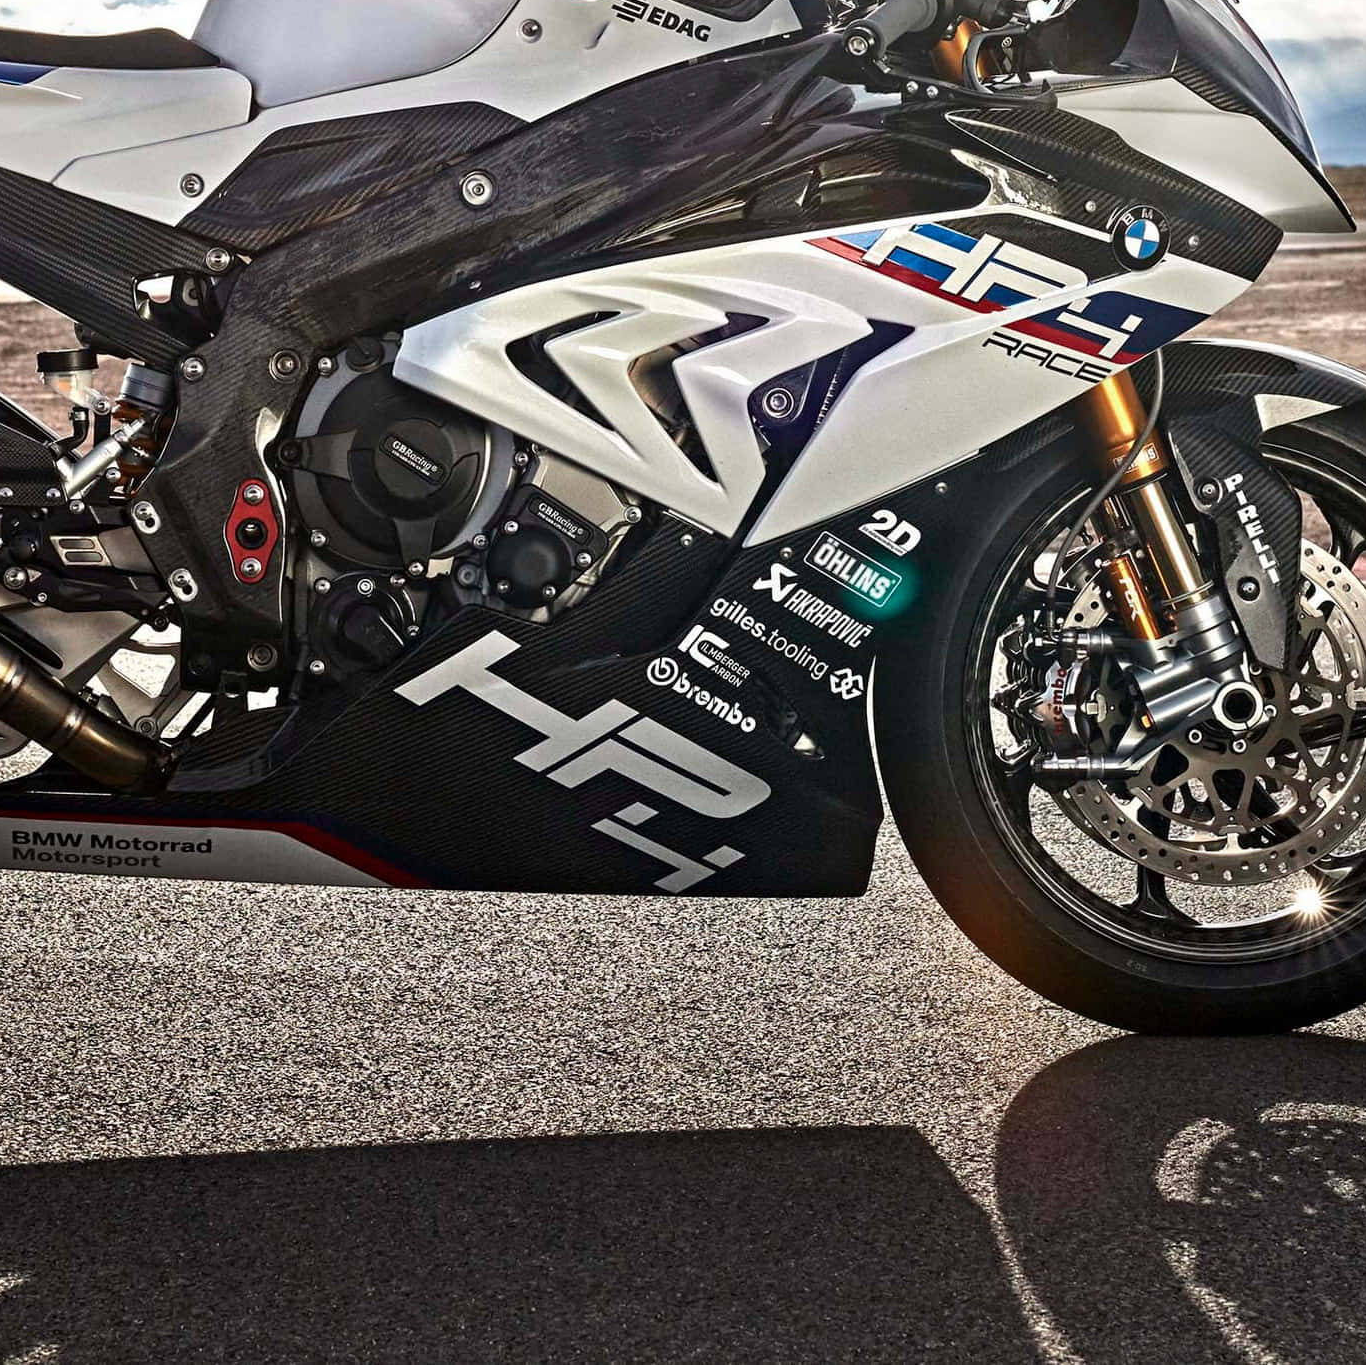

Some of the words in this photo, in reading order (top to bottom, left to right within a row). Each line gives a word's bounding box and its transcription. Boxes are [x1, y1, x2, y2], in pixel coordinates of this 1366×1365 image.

[647, 6, 711, 42] EDAG
[1122, 208, 1168, 233] BMW
[982, 331, 1112, 383] RACE
[858, 509, 921, 556] 2D
[1224, 473, 1280, 584] PIRELLI
[813, 537, 892, 599] ÖHLINS
[700, 642, 750, 679] ILMBERGER
[710, 597, 829, 680] gilles.tooling
[672, 672, 756, 732] brembo
[11, 830, 83, 847] BMW
[90, 834, 212, 853] Motorrad
[11, 846, 162, 868] Motorsport
